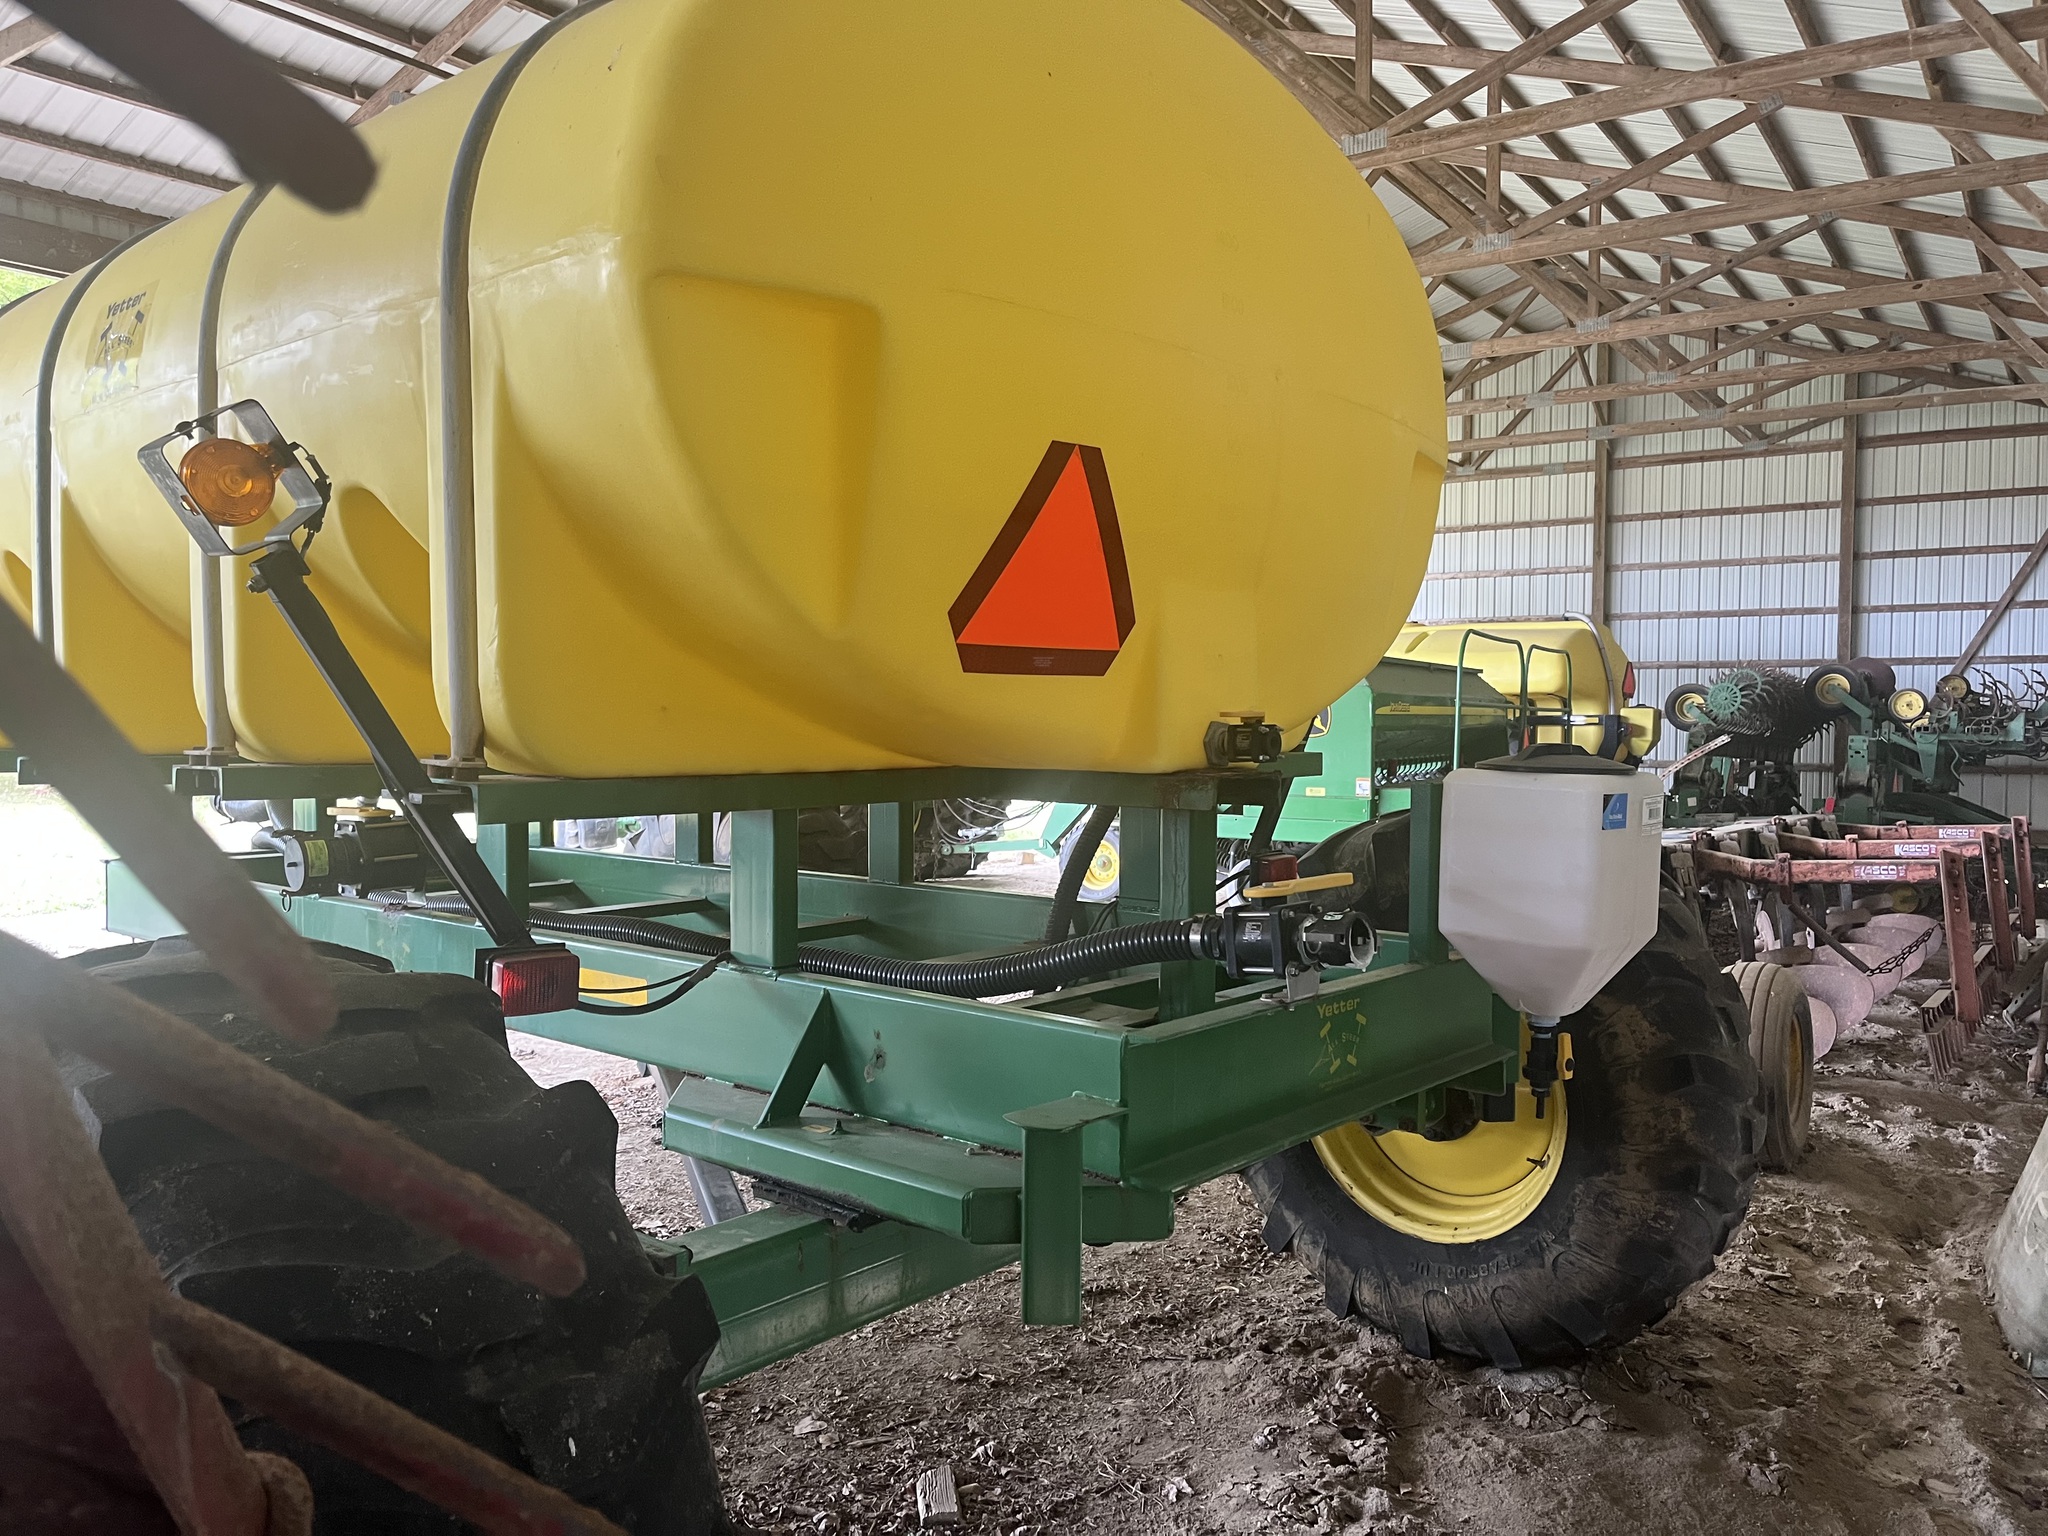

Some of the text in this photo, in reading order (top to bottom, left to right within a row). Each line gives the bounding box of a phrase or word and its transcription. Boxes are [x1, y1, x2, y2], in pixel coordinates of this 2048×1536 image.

[107, 291, 147, 319] Yetter
[1938, 828, 1969, 839] KASCO
[1894, 844, 1929, 856] KASCO
[1316, 998, 1360, 1019] Yetter
